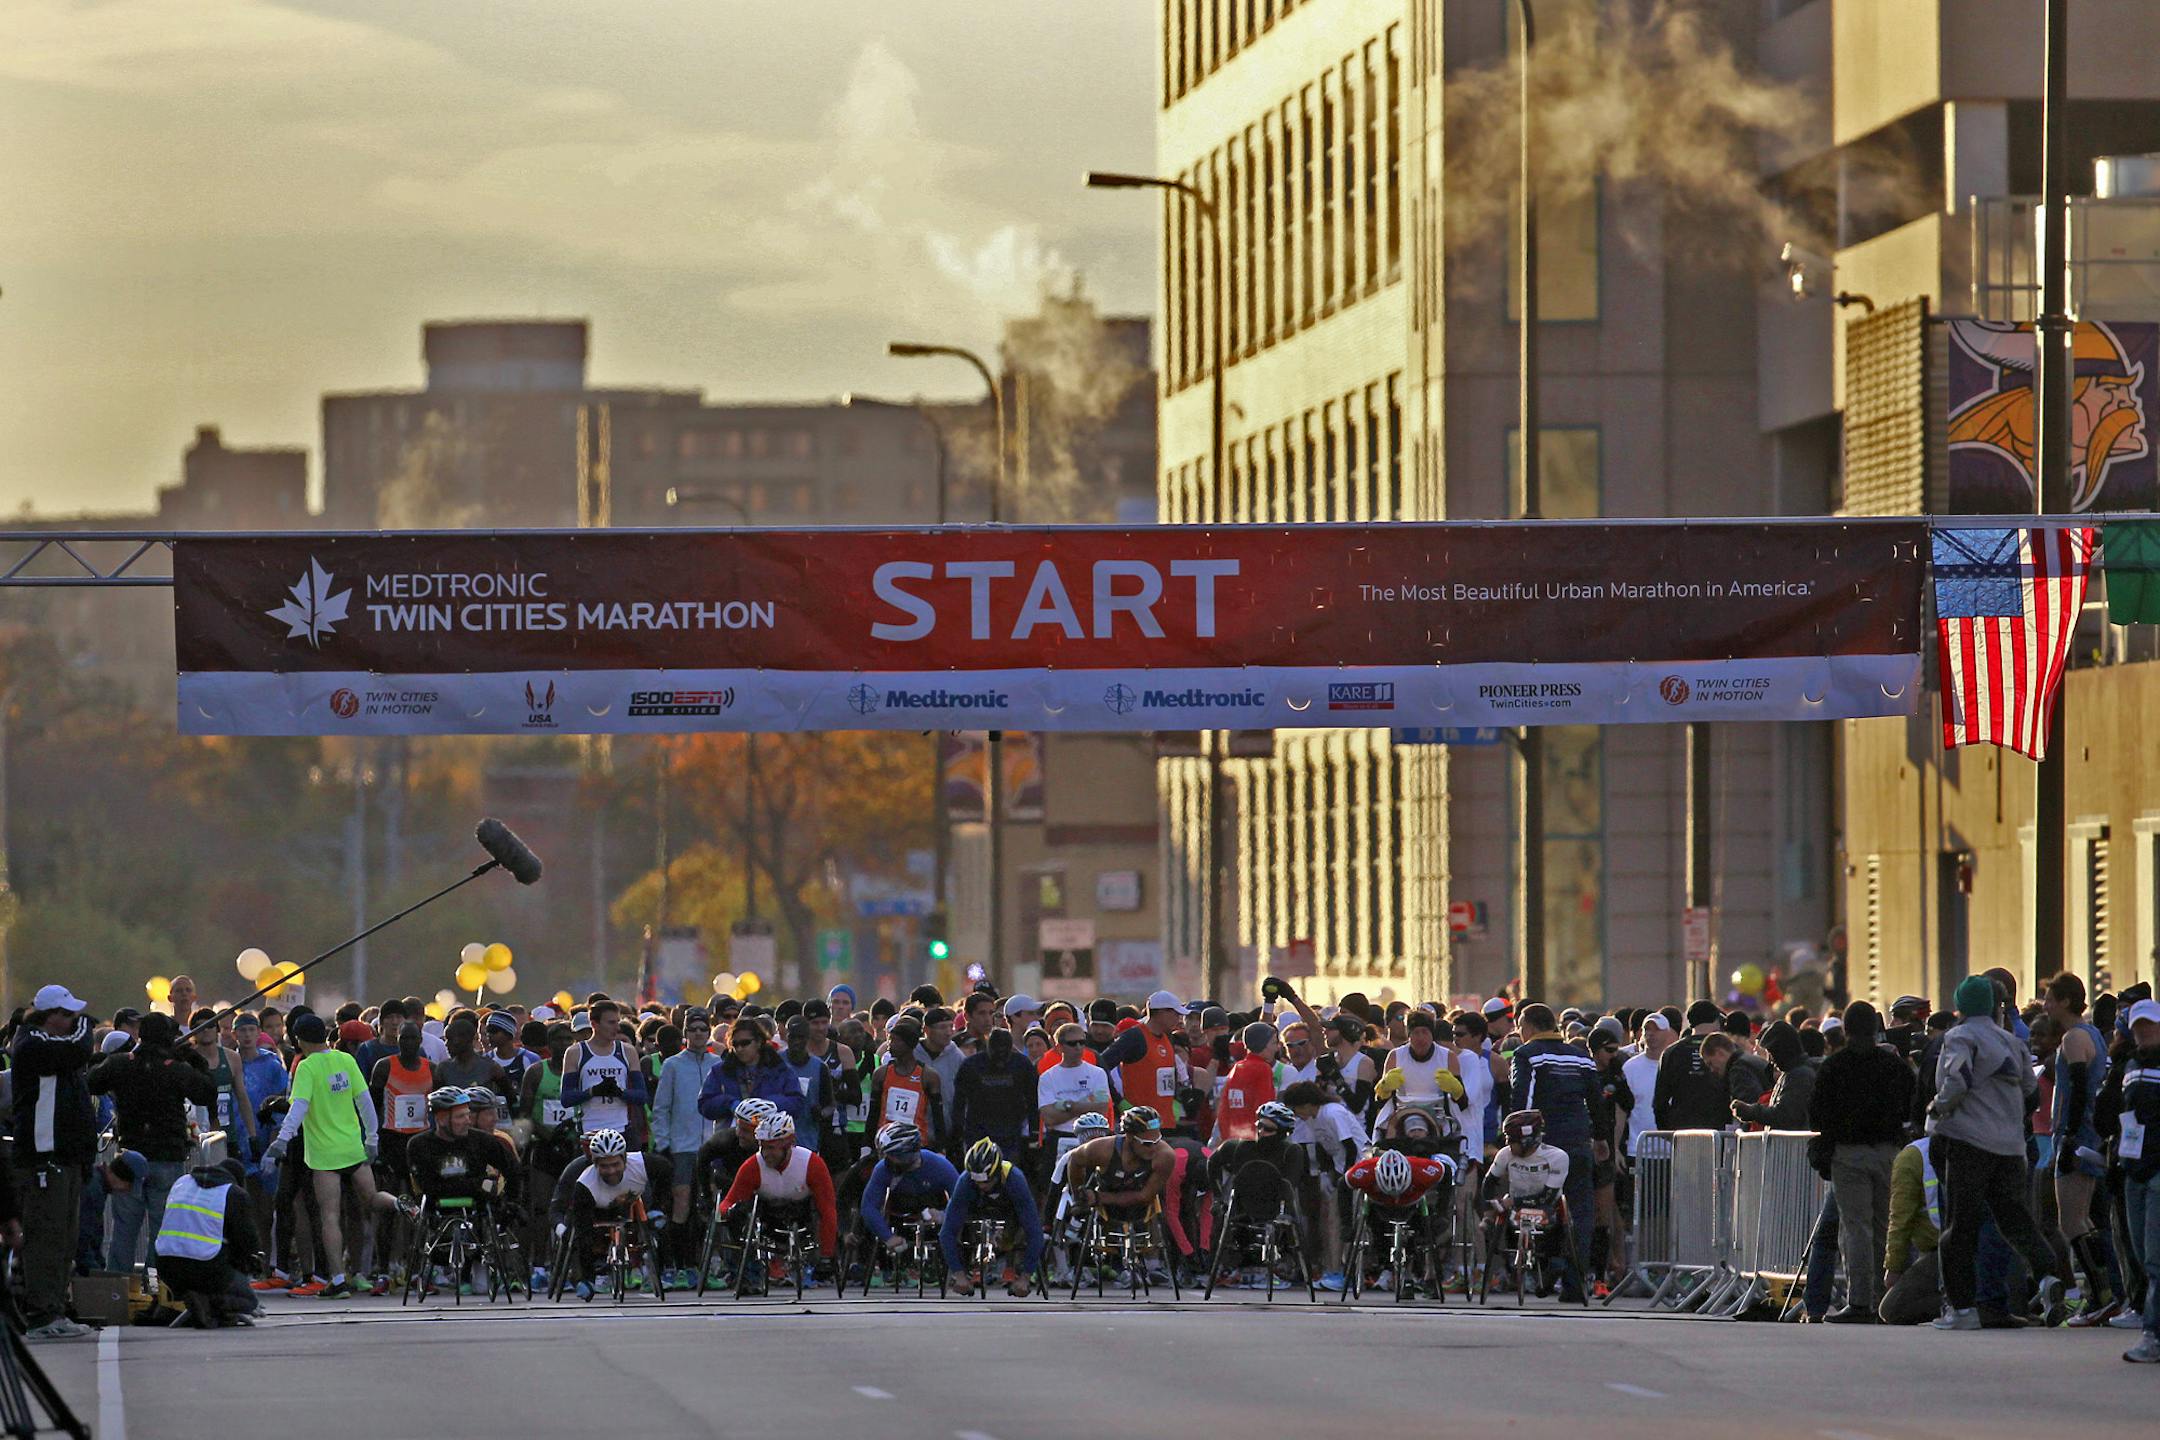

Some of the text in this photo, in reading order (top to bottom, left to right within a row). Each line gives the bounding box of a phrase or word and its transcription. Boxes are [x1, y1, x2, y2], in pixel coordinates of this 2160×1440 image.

[366, 573, 547, 598] MEDTRONIC
[1359, 584, 1395, 600] The
[1401, 585, 1447, 600] Most
[1453, 583, 1539, 600] Beautiful
[1546, 583, 1604, 599] Urban
[1610, 582, 1700, 598] Marathon
[1706, 581, 1723, 597] in
[870, 559, 1240, 641] START
[366, 601, 775, 632] TWIN CITIES MARATHON
[1695, 679, 1770, 688] TWIN CITIES
[366, 692, 438, 702] TWIN CITIES
[1331, 684, 1391, 700] KARE 11
[1480, 683, 1581, 698] PIONEER PRESS
[1696, 691, 1764, 700] IN MOTION
[886, 690, 1008, 708] Medtronic
[1142, 688, 1265, 707] Medtronic
[366, 705, 432, 714] IN MOTION
[528, 714, 552, 723] USA
[587, 1068, 622, 1076] WRRT
[407, 1105, 414, 1118] 8
[895, 1100, 908, 1113] 14
[553, 1110, 566, 1121] 12
